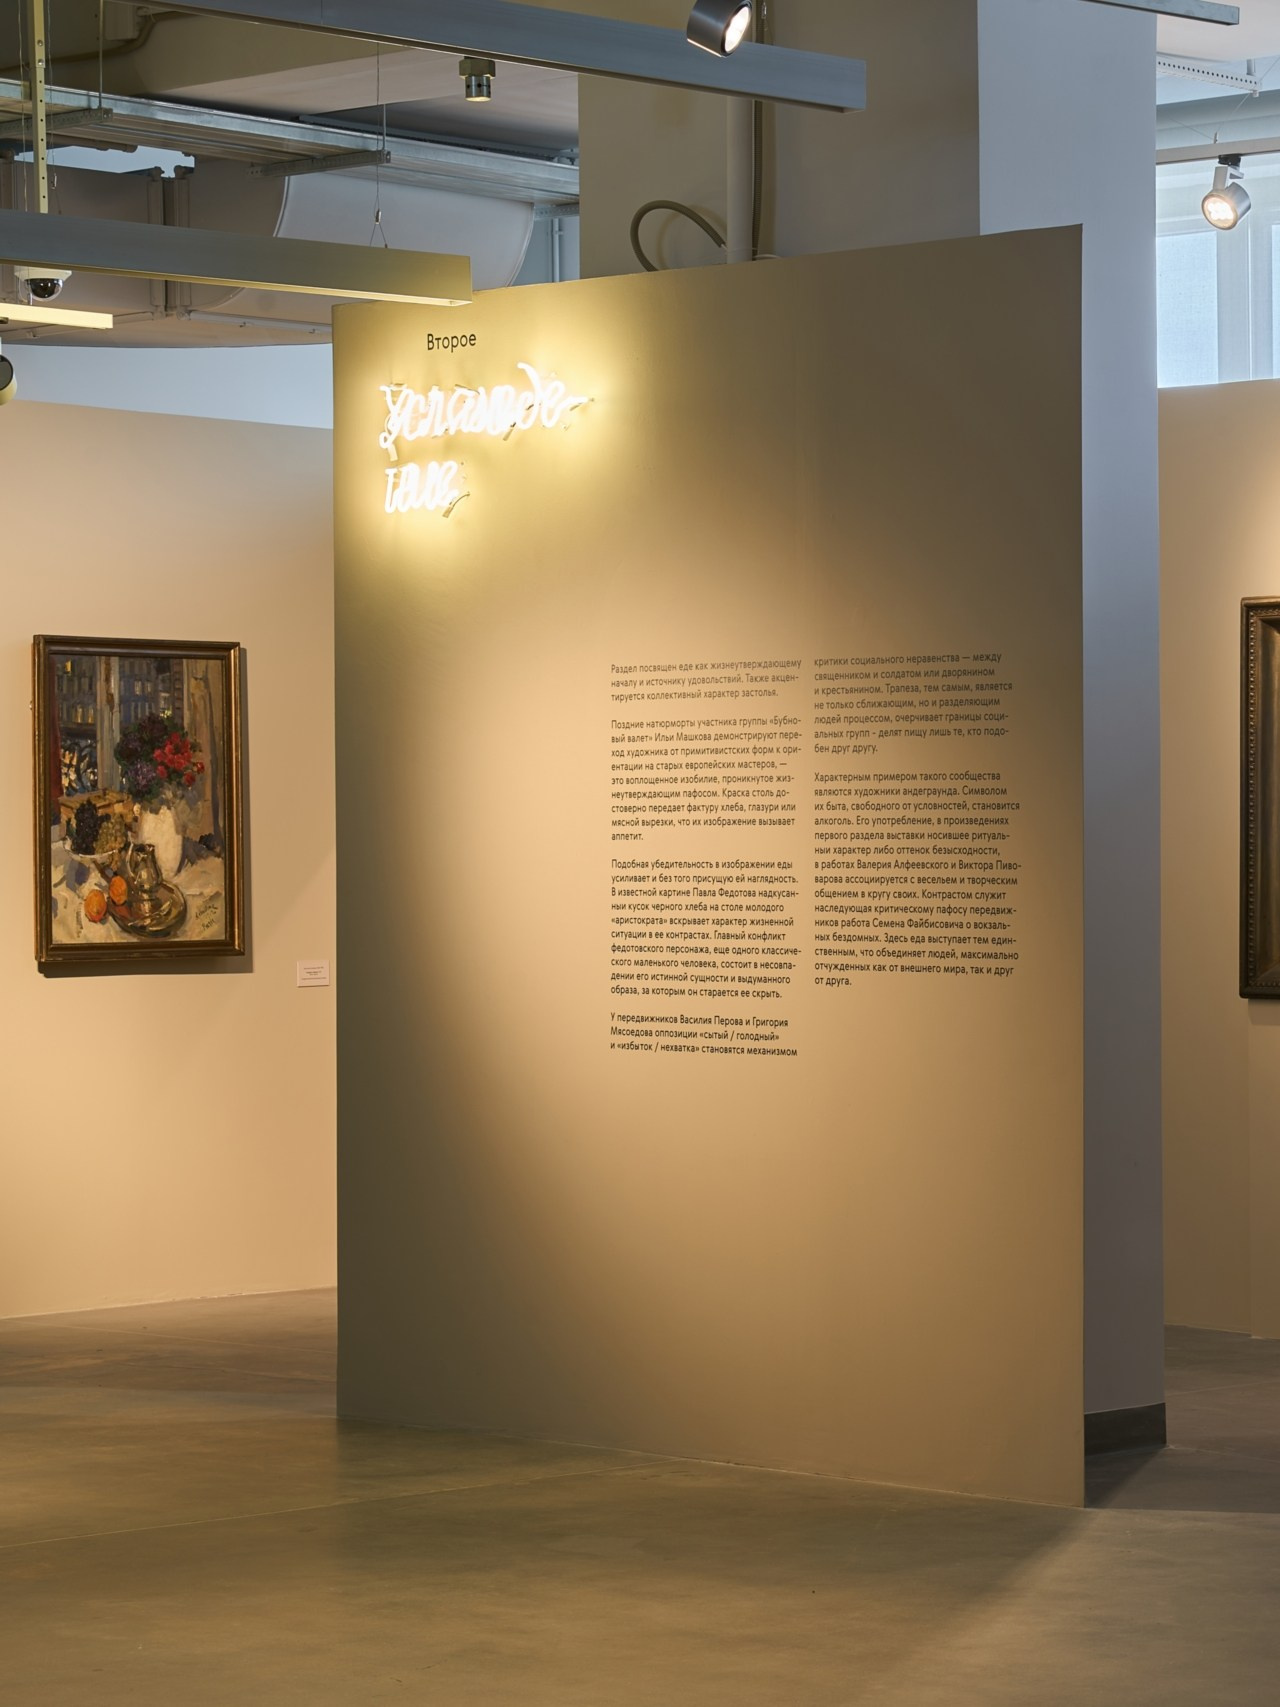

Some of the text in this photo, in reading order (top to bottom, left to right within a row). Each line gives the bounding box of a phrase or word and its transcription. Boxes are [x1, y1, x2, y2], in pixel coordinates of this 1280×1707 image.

[427, 333, 477, 352] Второе
[611, 659, 801, 675] Раздел посвящен еде как жизнеутверждающему
[611, 672, 798, 690] началу и источнику удовольствий. Также акцен-
[814, 667, 995, 682] священником и солдатом или дворянином
[611, 688, 778, 704] тируется коллективный характер застолья.
[611, 714, 801, 731] Поздние натюрморты участника группы «Бубно-
[814, 712, 1008, 726] людей процессом, очерчивает границы соци-
[611, 730, 802, 743] вый валет» Ильи Машкова демонстрируют пере-
[814, 742, 878, 755] бен друг другу.
[611, 773, 794, 786] это воплощенное изобилие, проникнутое жиз-
[814, 770, 1000, 784] Характерным примером такого сообщества
[611, 787, 789, 801] неутверждающим пафосом. Краска столь до-
[814, 784, 1007, 798] являются художники андеграунда. Символом
[611, 801, 796, 815] стоверно передает фактуру хлеба, глазури или
[814, 800, 1020, 812] их быта, свободного от условностей, становится
[611, 815, 795, 829] мясной вырезки, что их изображение вызывает
[814, 814, 1009, 827] алкоголь. Его употребление, в произведениях
[814, 831, 1010, 842] первого раздела выставки носившее ритуаль-
[611, 858, 792, 871] Подобная убедительность в изображении еды
[814, 858, 1021, 872] в работах Валерия Алфеевского и Виктора Пиво-
[611, 886, 799, 900] В известной картине Павла Федотова надкусан-
[814, 887, 1006, 902] общением в кругу своих. Контрастом служит
[814, 903, 1016, 917] наследующая критическому пафосу передвиж-
[611, 916, 794, 928] «аристократа» вскрывает характер жизненной
[814, 916, 1010, 930] ников работа Семена Файбисовича о вокзаль-
[610, 941, 801, 956] федотовского персонажа, еще одного классиче-
[814, 946, 1018, 960] ственным, что объединяет людей, максимально
[610, 970, 790, 986] дении его истинной сущности и выдуманного
[814, 977, 852, 988] от друга.
[610, 1011, 788, 1030] У передвижников Василия Перова и Григория
